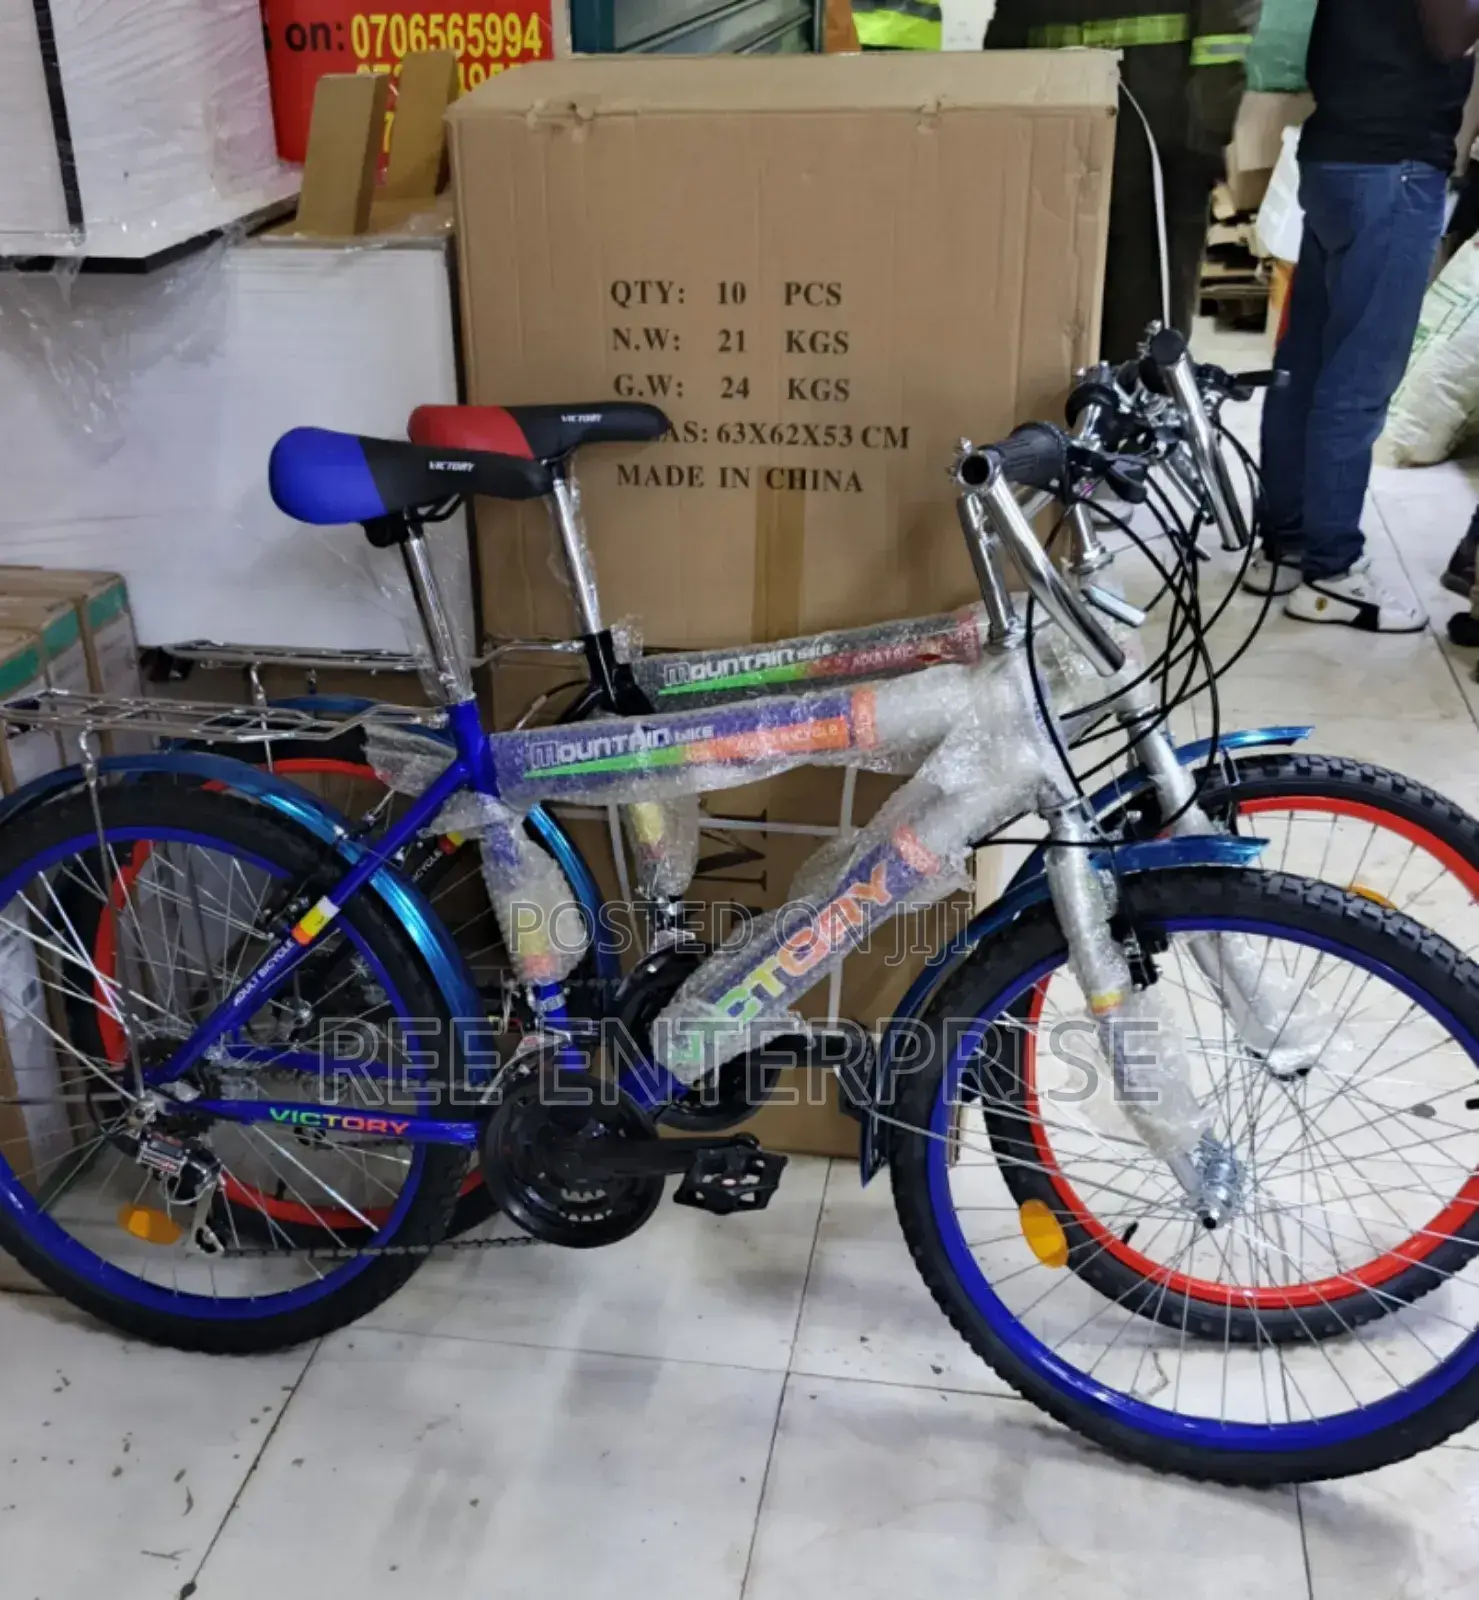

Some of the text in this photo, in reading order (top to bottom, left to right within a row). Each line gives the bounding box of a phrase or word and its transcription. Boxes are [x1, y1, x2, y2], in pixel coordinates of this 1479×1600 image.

[284, 22, 344, 51] on:
[352, 13, 542, 57] 0706565994
[610, 280, 843, 308] QTY: 10 PCS
[612, 327, 850, 355] N.W: 21 KGS
[613, 374, 850, 402] G.W: 24 KGS
[660, 421, 911, 450] AS: 63X62X53 CM
[428, 460, 474, 473] VICTORY
[616, 464, 864, 493] MADE IN CHINA
[268, 1106, 410, 1136] VICTORY
